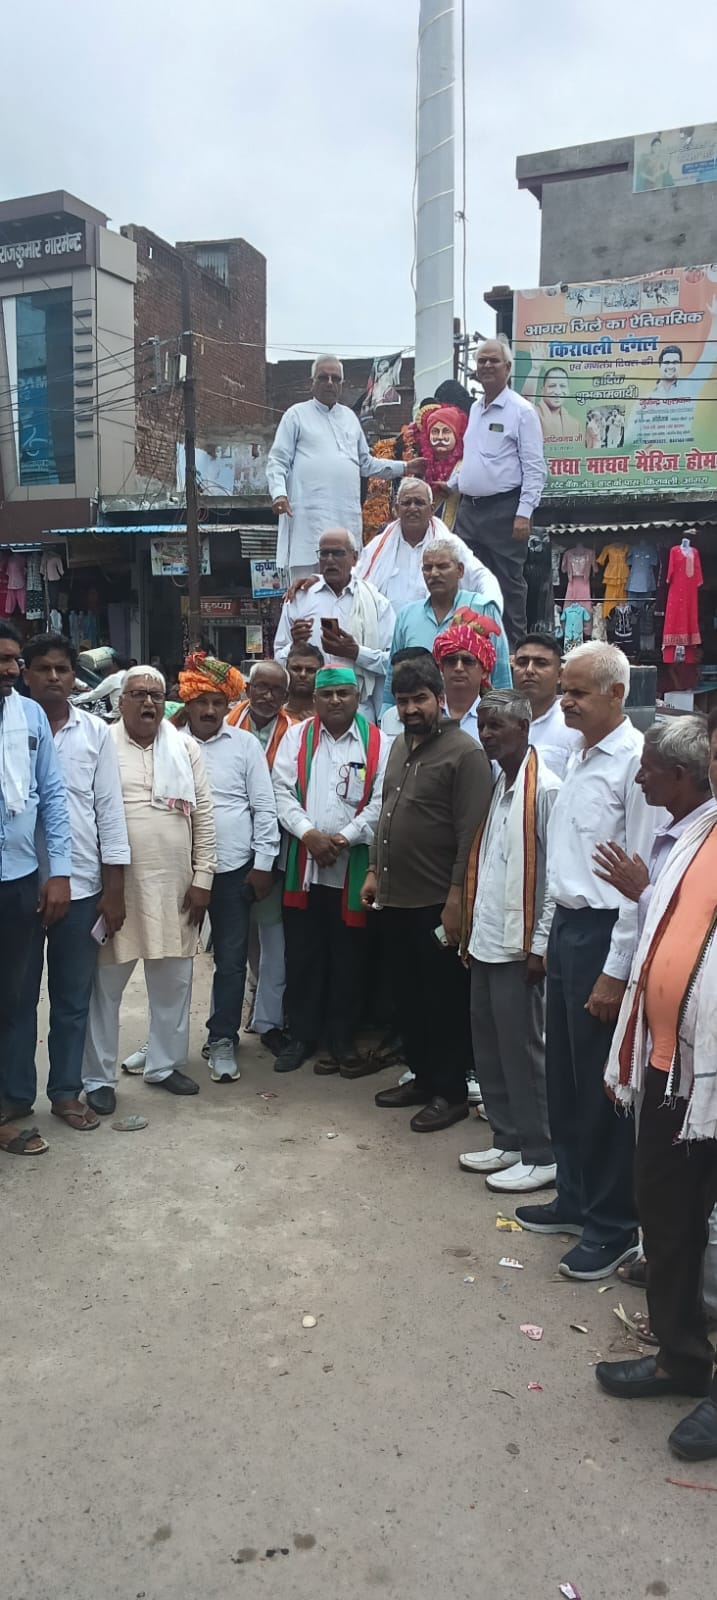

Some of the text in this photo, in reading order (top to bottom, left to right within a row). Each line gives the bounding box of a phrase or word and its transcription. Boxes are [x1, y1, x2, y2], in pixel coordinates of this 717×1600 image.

[524, 310, 703, 337] आगरा जिले का ऐतिहासिक
[548, 334, 660, 359] किरावली दंगल
[635, 449, 680, 472] मैरिज
[685, 447, 717, 471] होम
